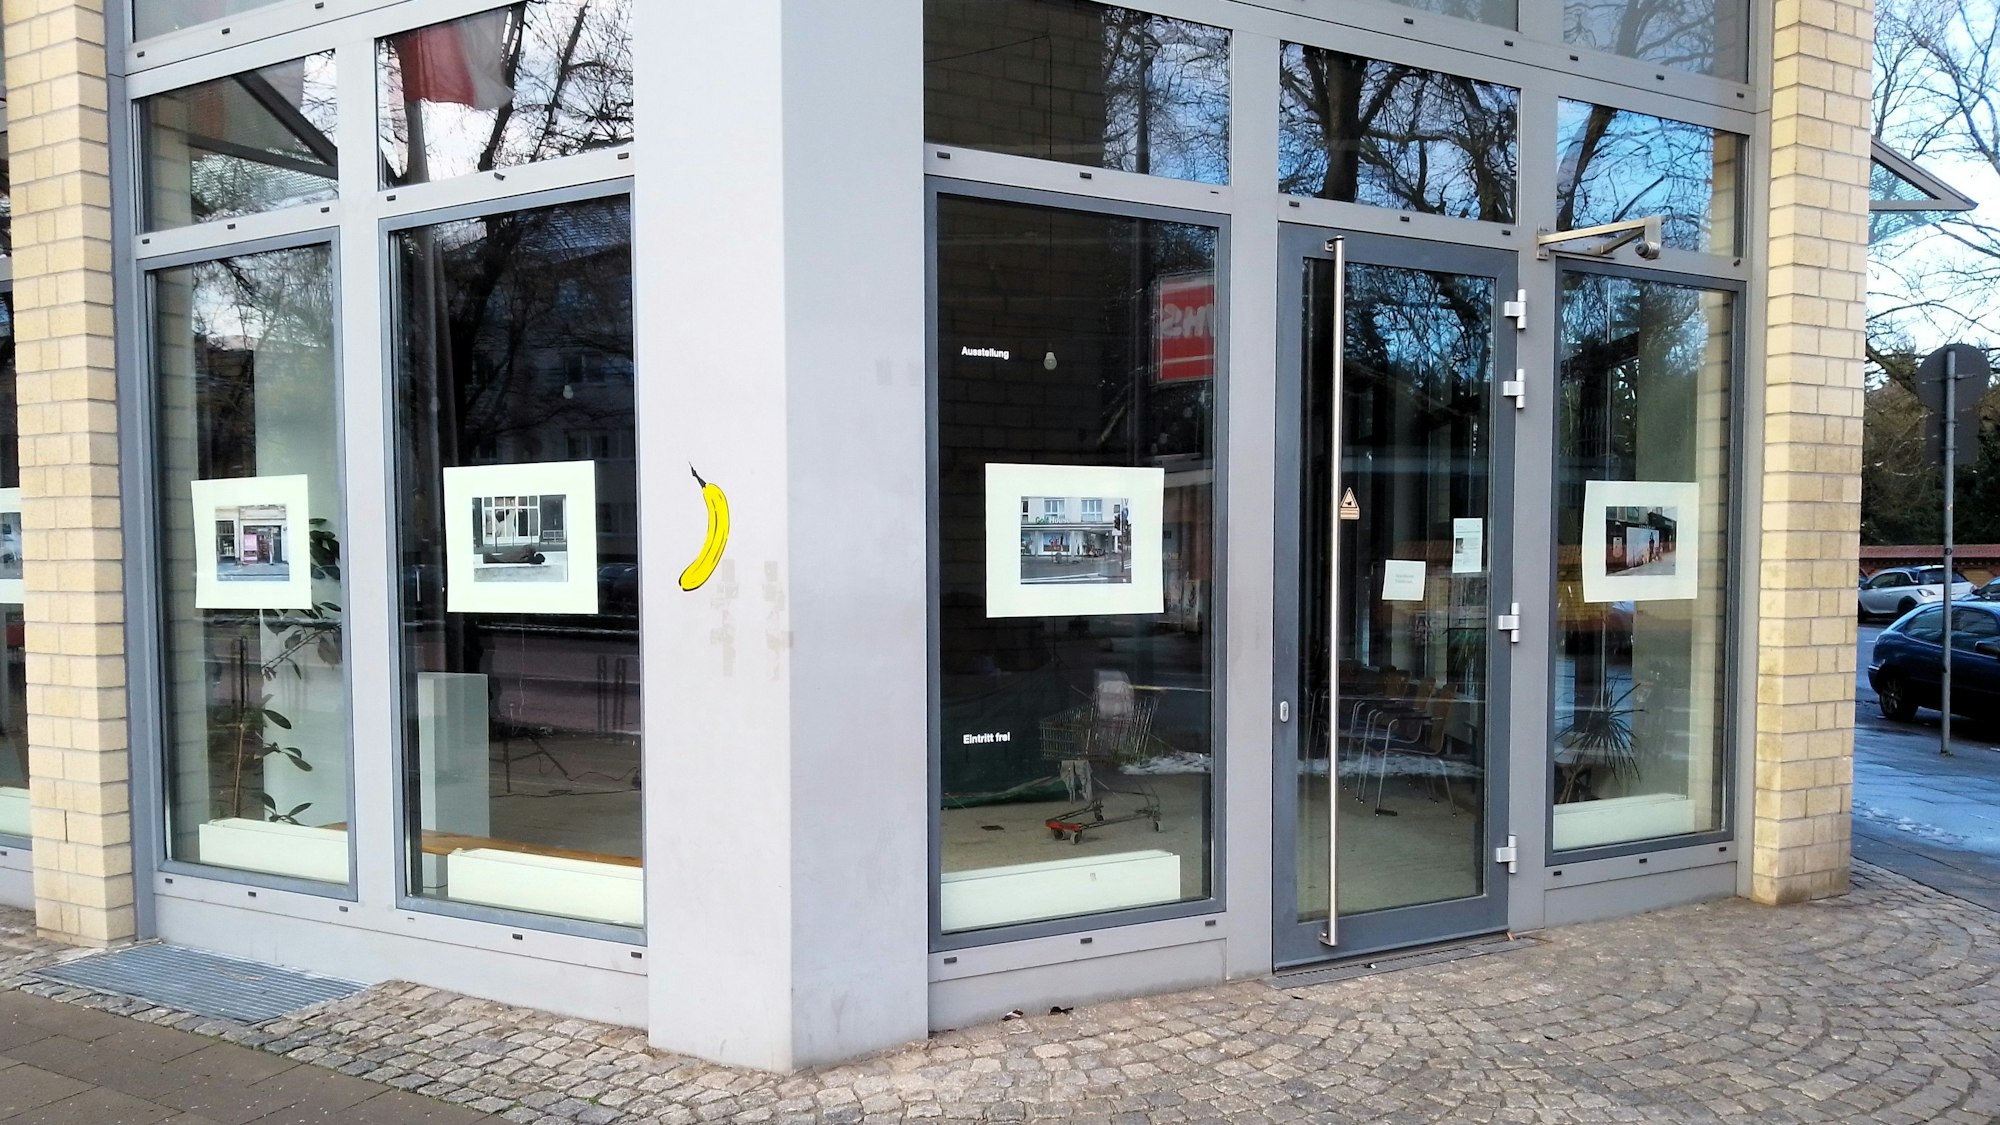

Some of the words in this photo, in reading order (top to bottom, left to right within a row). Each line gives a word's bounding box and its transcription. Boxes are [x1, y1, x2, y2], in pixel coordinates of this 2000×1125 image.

[961, 346, 1010, 360] Ausstellung
[963, 733, 994, 744] Eintritt
[995, 731, 1010, 742] frei
